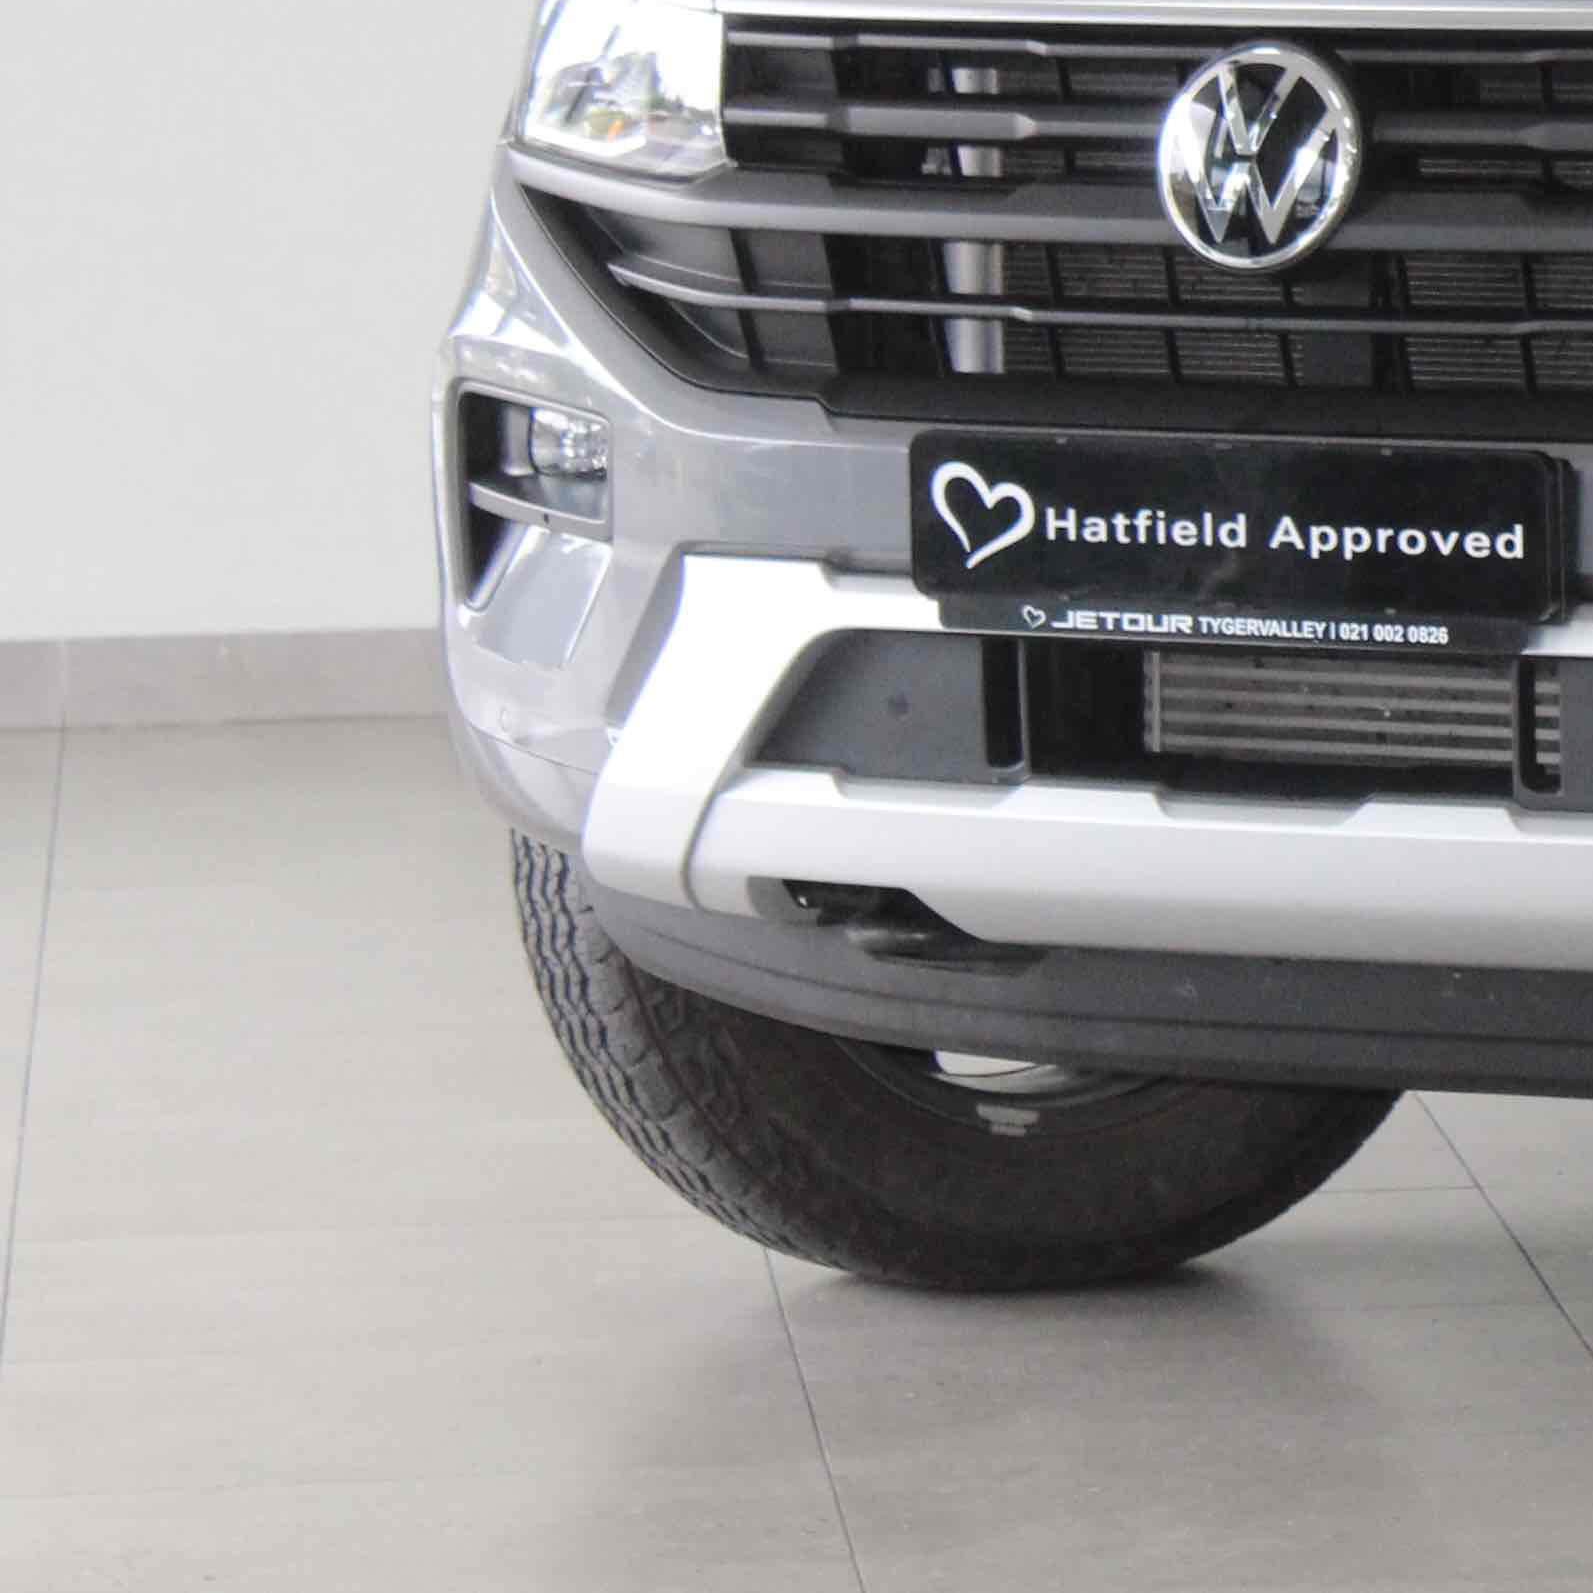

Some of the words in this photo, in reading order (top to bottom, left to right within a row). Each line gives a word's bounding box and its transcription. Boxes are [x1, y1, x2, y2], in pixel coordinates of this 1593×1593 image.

[1045, 507, 1247, 549] Hatfield
[1269, 516, 1525, 561] Approved
[1051, 610, 1194, 634] JETOUR
[1198, 616, 1328, 640] TYGERVALLEY
[1339, 623, 1369, 641] 021
[1373, 624, 1404, 643] 002
